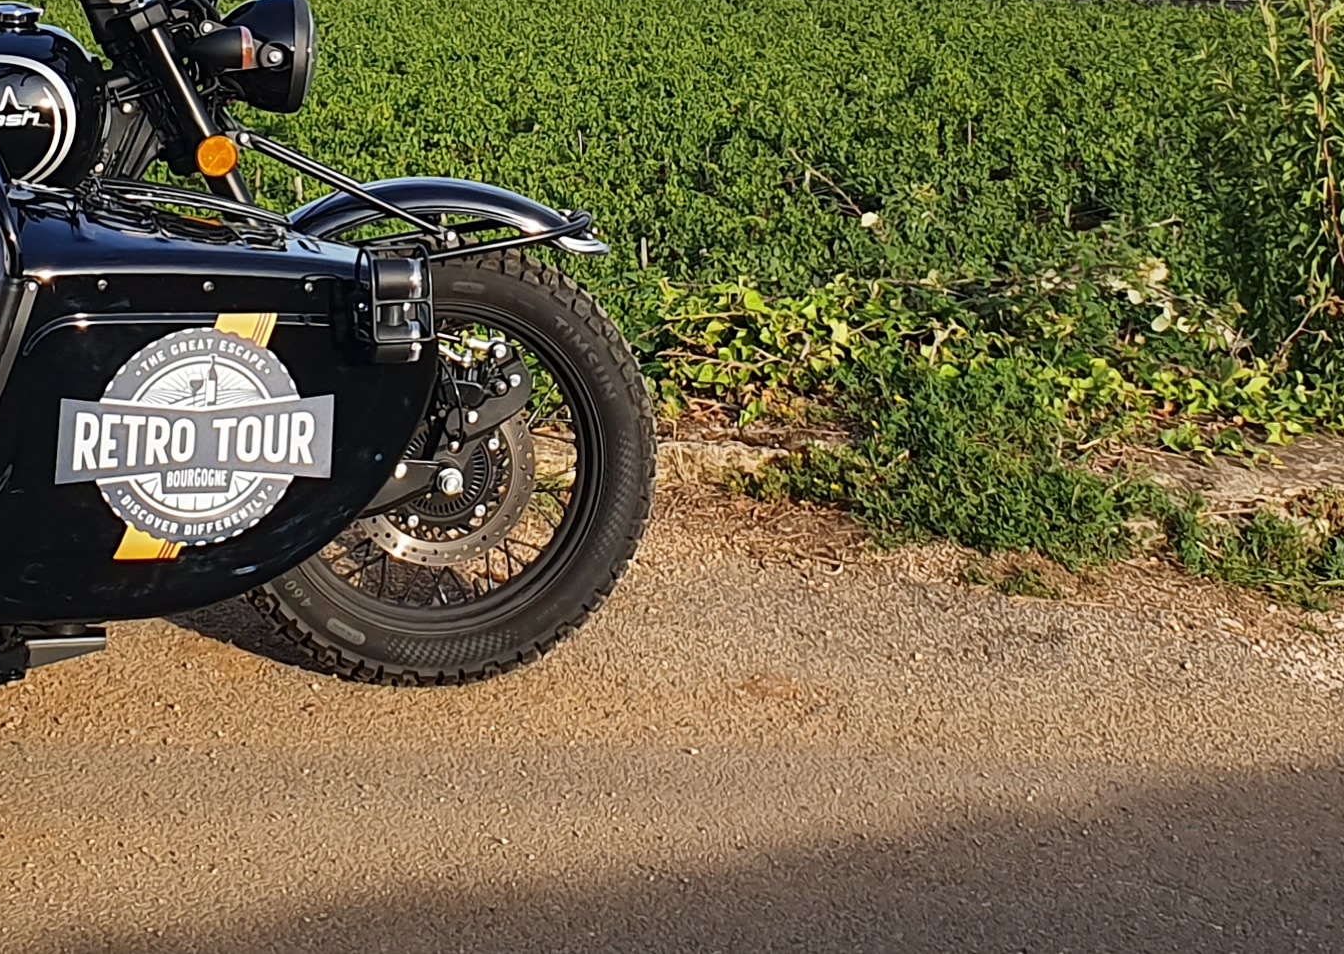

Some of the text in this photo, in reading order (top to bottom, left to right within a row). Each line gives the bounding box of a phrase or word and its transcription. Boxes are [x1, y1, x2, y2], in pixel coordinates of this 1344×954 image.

[140, 338, 267, 373] THE GREAT ESCAPE
[554, 315, 618, 400] TIMSUN
[72, 411, 316, 472] RETRO TOUR
[165, 467, 229, 489] BOURGOGNE
[119, 489, 269, 537] DISCOVER DIFFERENTLY
